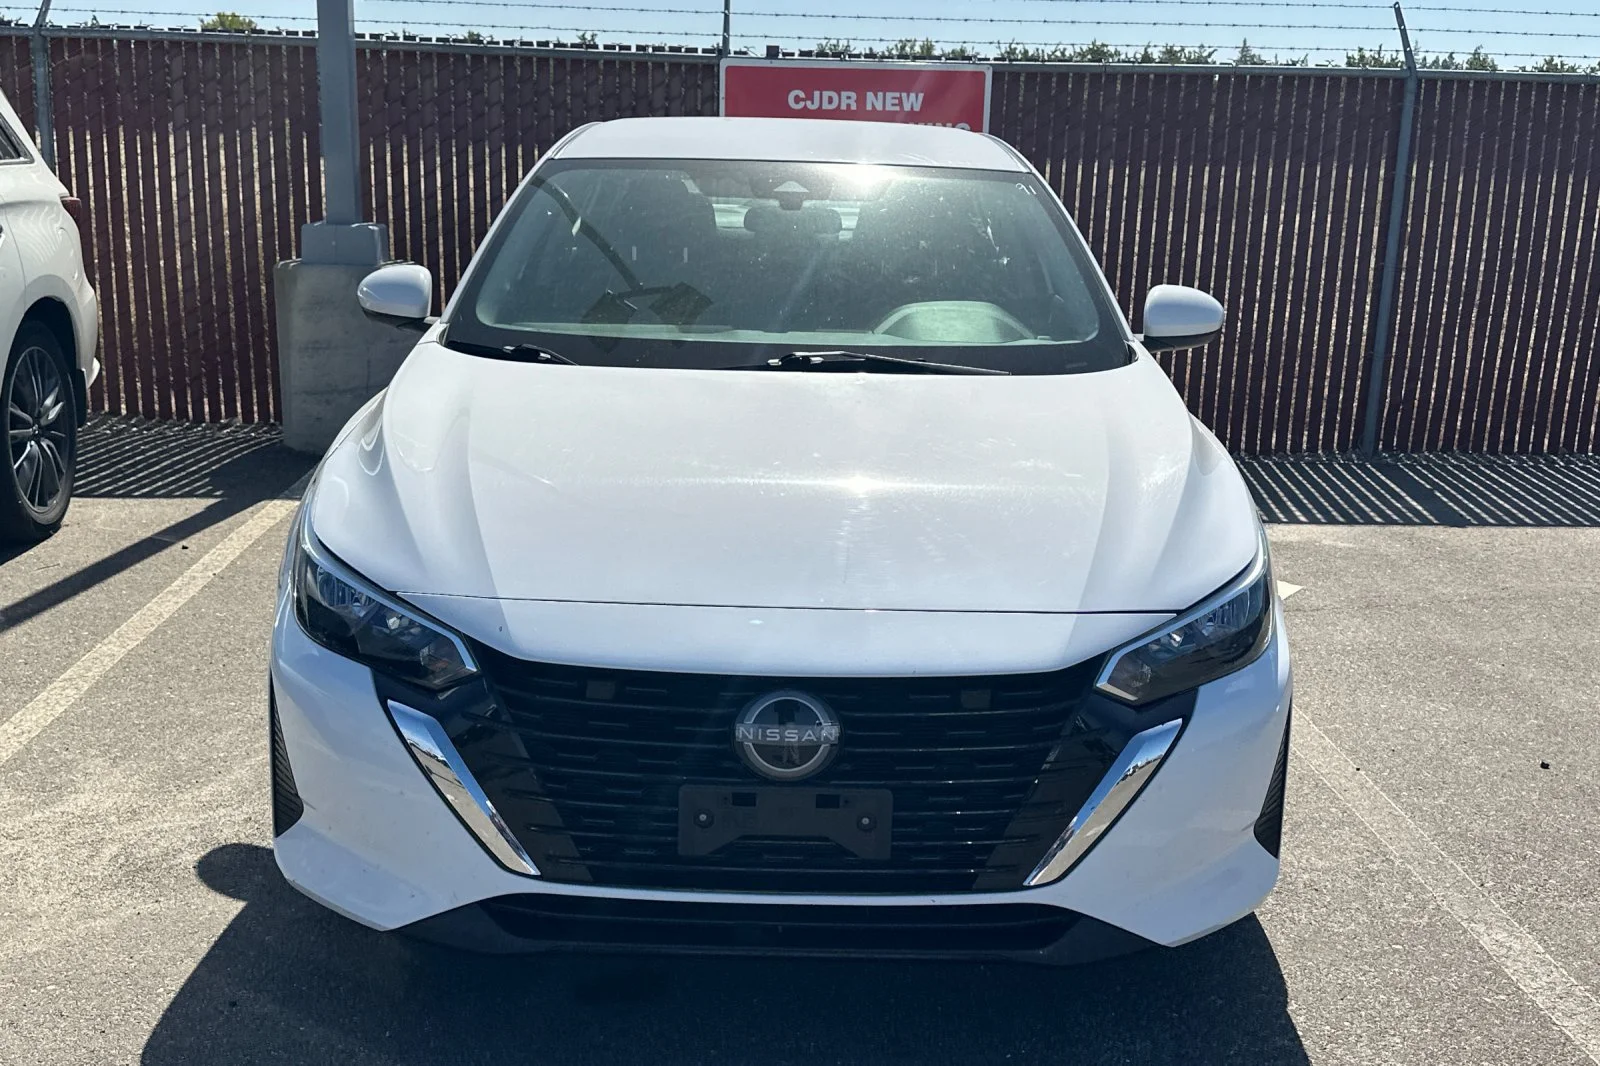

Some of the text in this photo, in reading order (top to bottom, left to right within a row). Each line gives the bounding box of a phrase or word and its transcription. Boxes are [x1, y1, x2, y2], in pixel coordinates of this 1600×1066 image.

[787, 89, 925, 112] CJDR NEW
[738, 726, 837, 742] NISSAN
